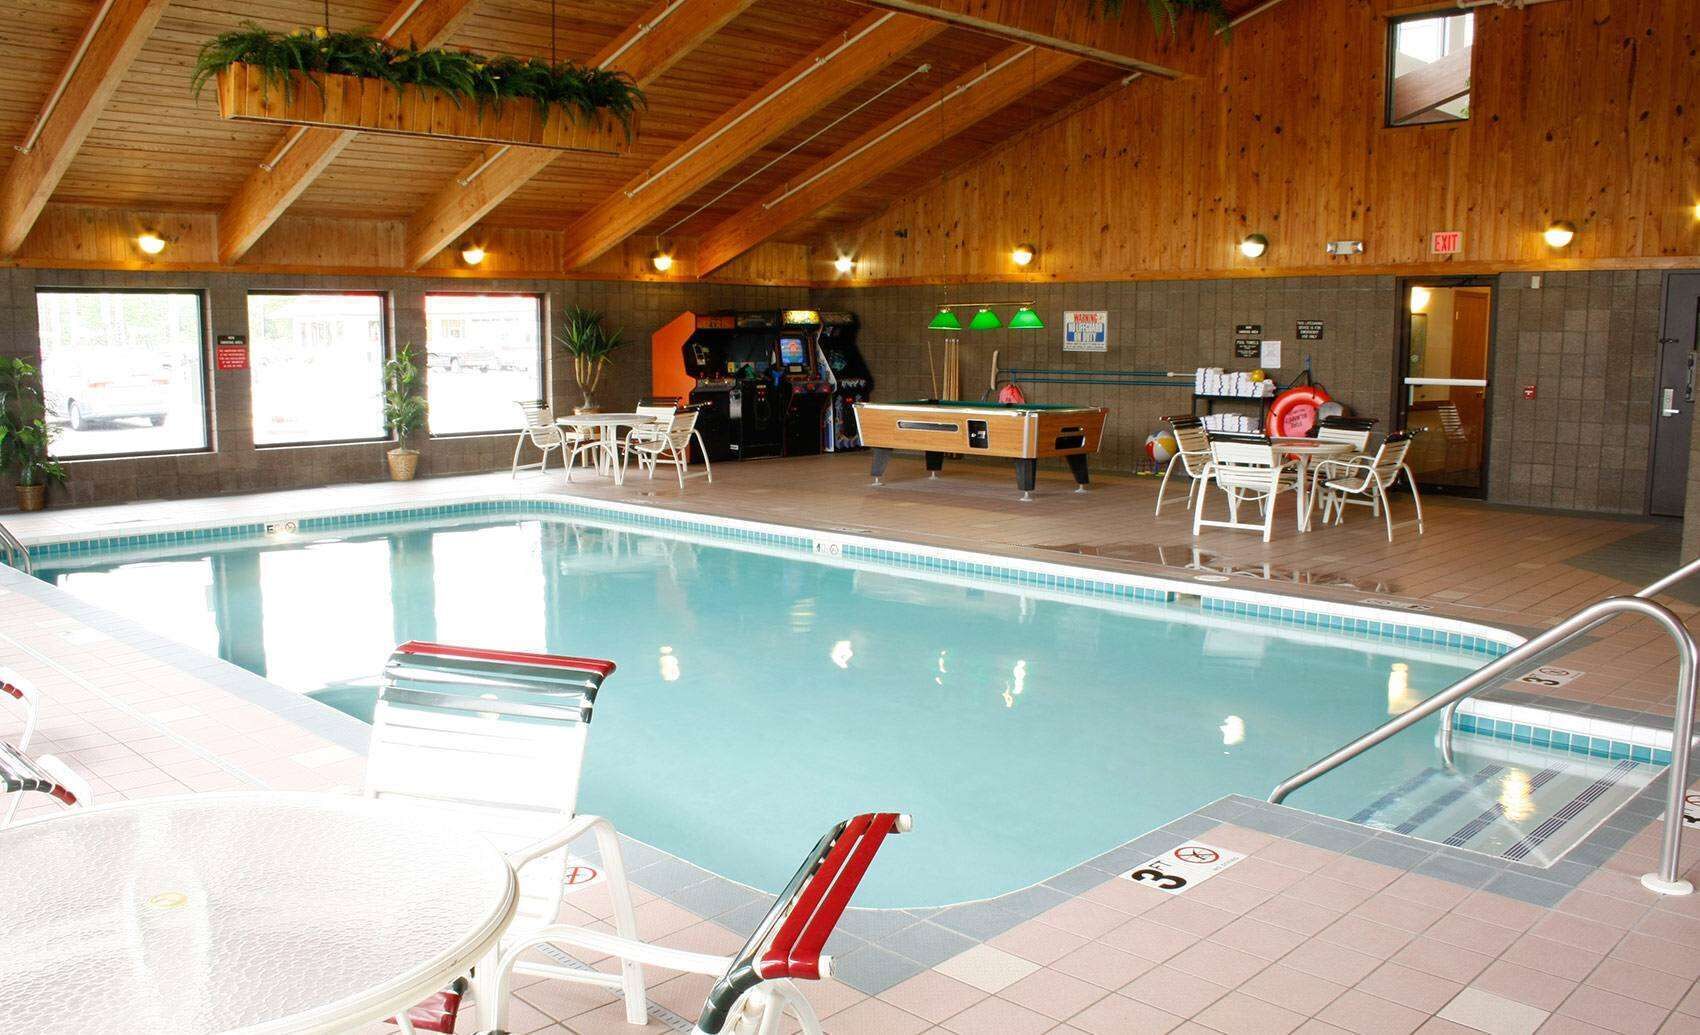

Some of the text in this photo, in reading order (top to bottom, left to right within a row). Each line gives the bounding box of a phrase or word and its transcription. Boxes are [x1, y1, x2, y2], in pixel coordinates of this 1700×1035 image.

[1435, 234, 1458, 251] EXIT
[1522, 677, 1560, 685] 3
[1131, 869, 1187, 890] 3
